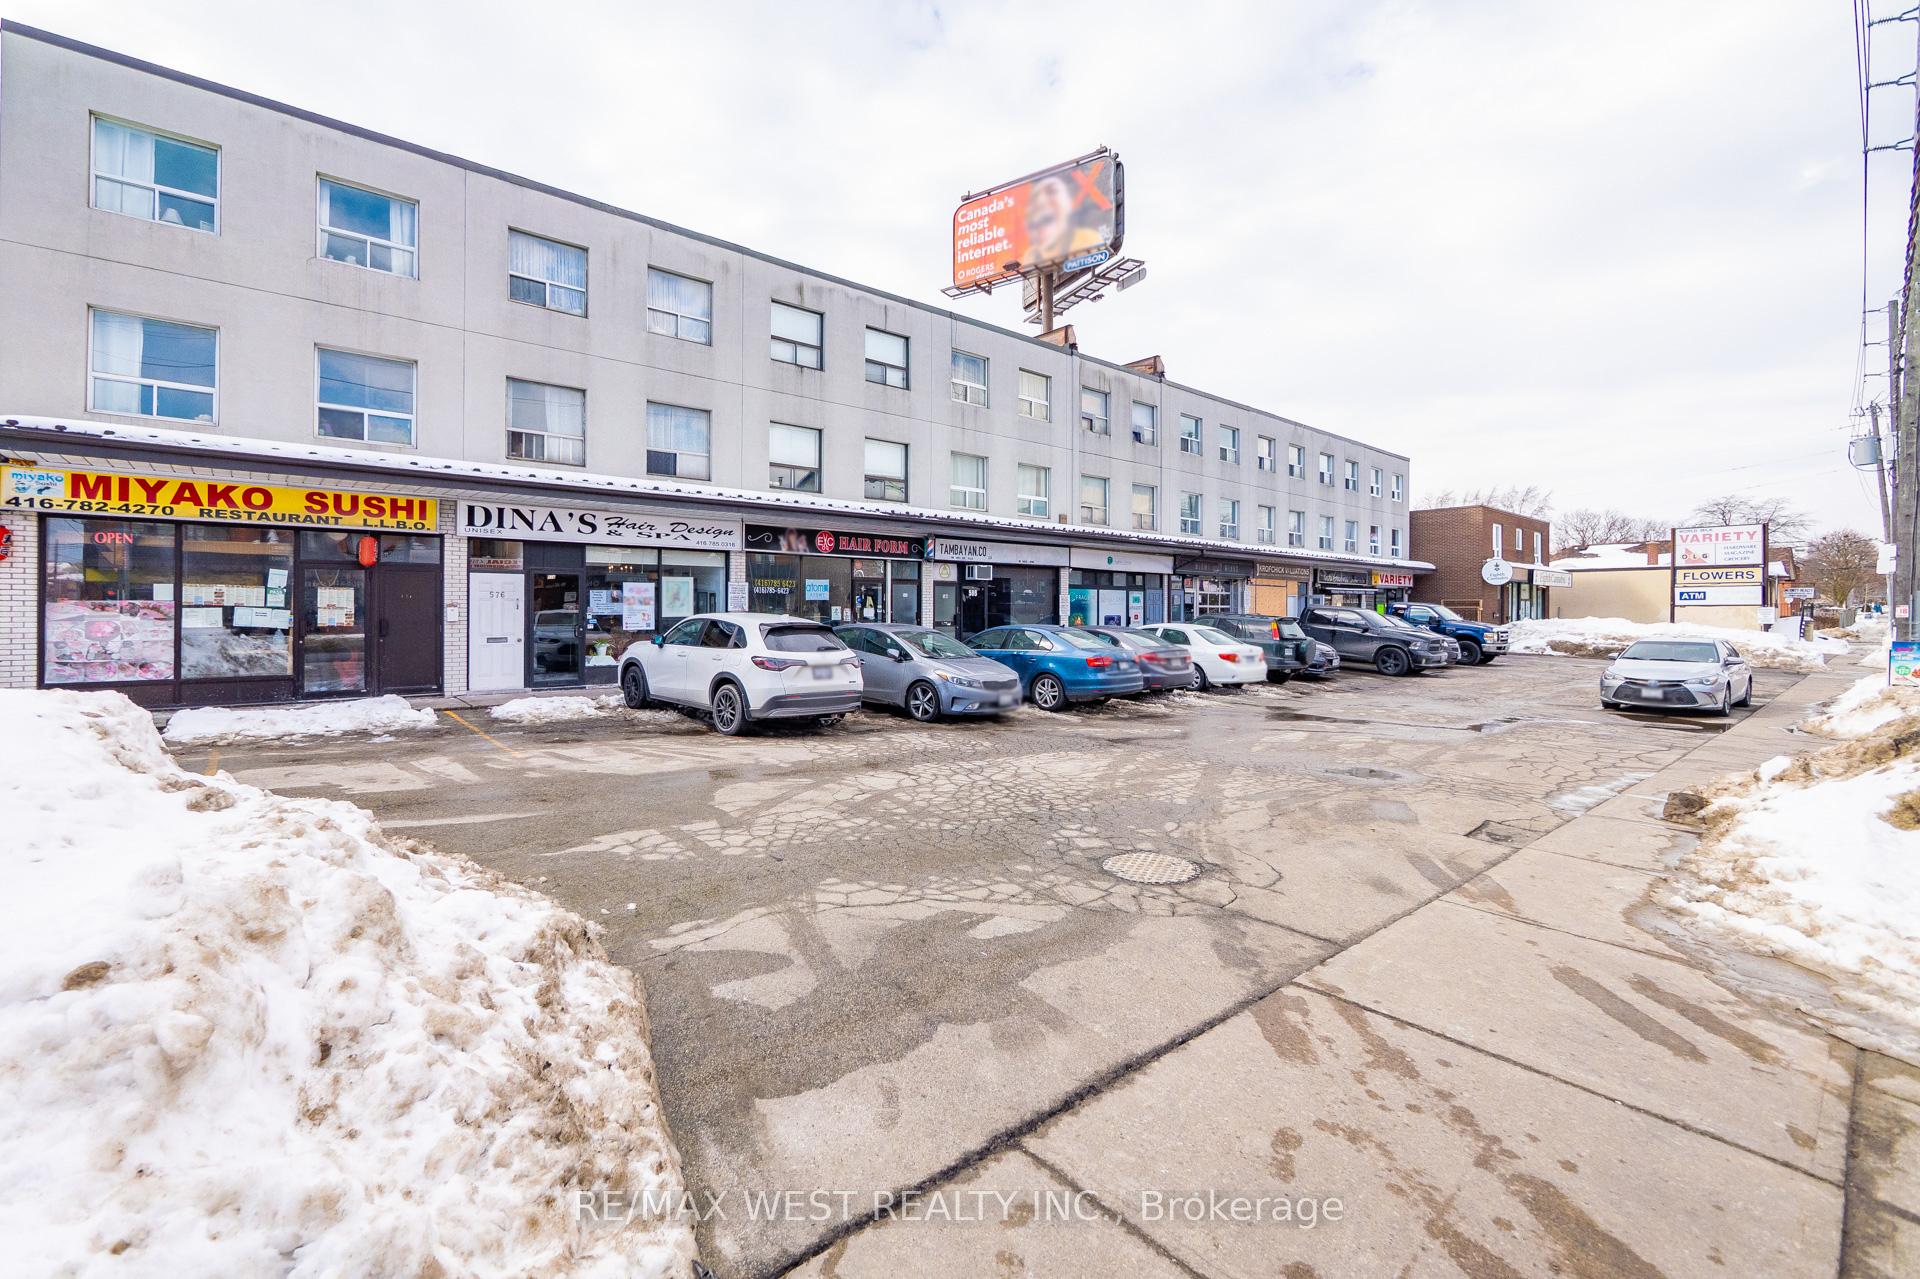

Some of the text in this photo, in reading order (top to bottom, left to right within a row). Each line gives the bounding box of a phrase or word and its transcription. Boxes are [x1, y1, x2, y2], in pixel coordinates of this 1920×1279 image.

[957, 195, 1015, 223] Canada's
[957, 217, 990, 235] most
[957, 225, 1006, 250] reliable
[957, 239, 1013, 264] internet.
[1066, 252, 1106, 271] PATTISON
[965, 262, 995, 277] ROGERS
[11, 472, 64, 483] miyako
[70, 473, 428, 521] MIYAKO SUSHI
[5, 496, 175, 516] 416-782-4270
[199, 508, 431, 531] RESTAURANT L.L.B.O.
[466, 504, 736, 539] DINA'S Hair Design
[94, 532, 134, 545] OPEN
[464, 527, 503, 536] UNISEX
[636, 530, 692, 541] SPA
[1679, 530, 1758, 544] VARIETY
[838, 536, 909, 555] HAIR FORM
[940, 543, 987, 557] TAMBAYAN.CO
[1260, 563, 1285, 575] KROFCHICK
[1683, 570, 1755, 581] FLOWERS
[1380, 574, 1412, 586] VARIETY
[489, 591, 506, 599] 576
[1681, 592, 1705, 600] ATM
